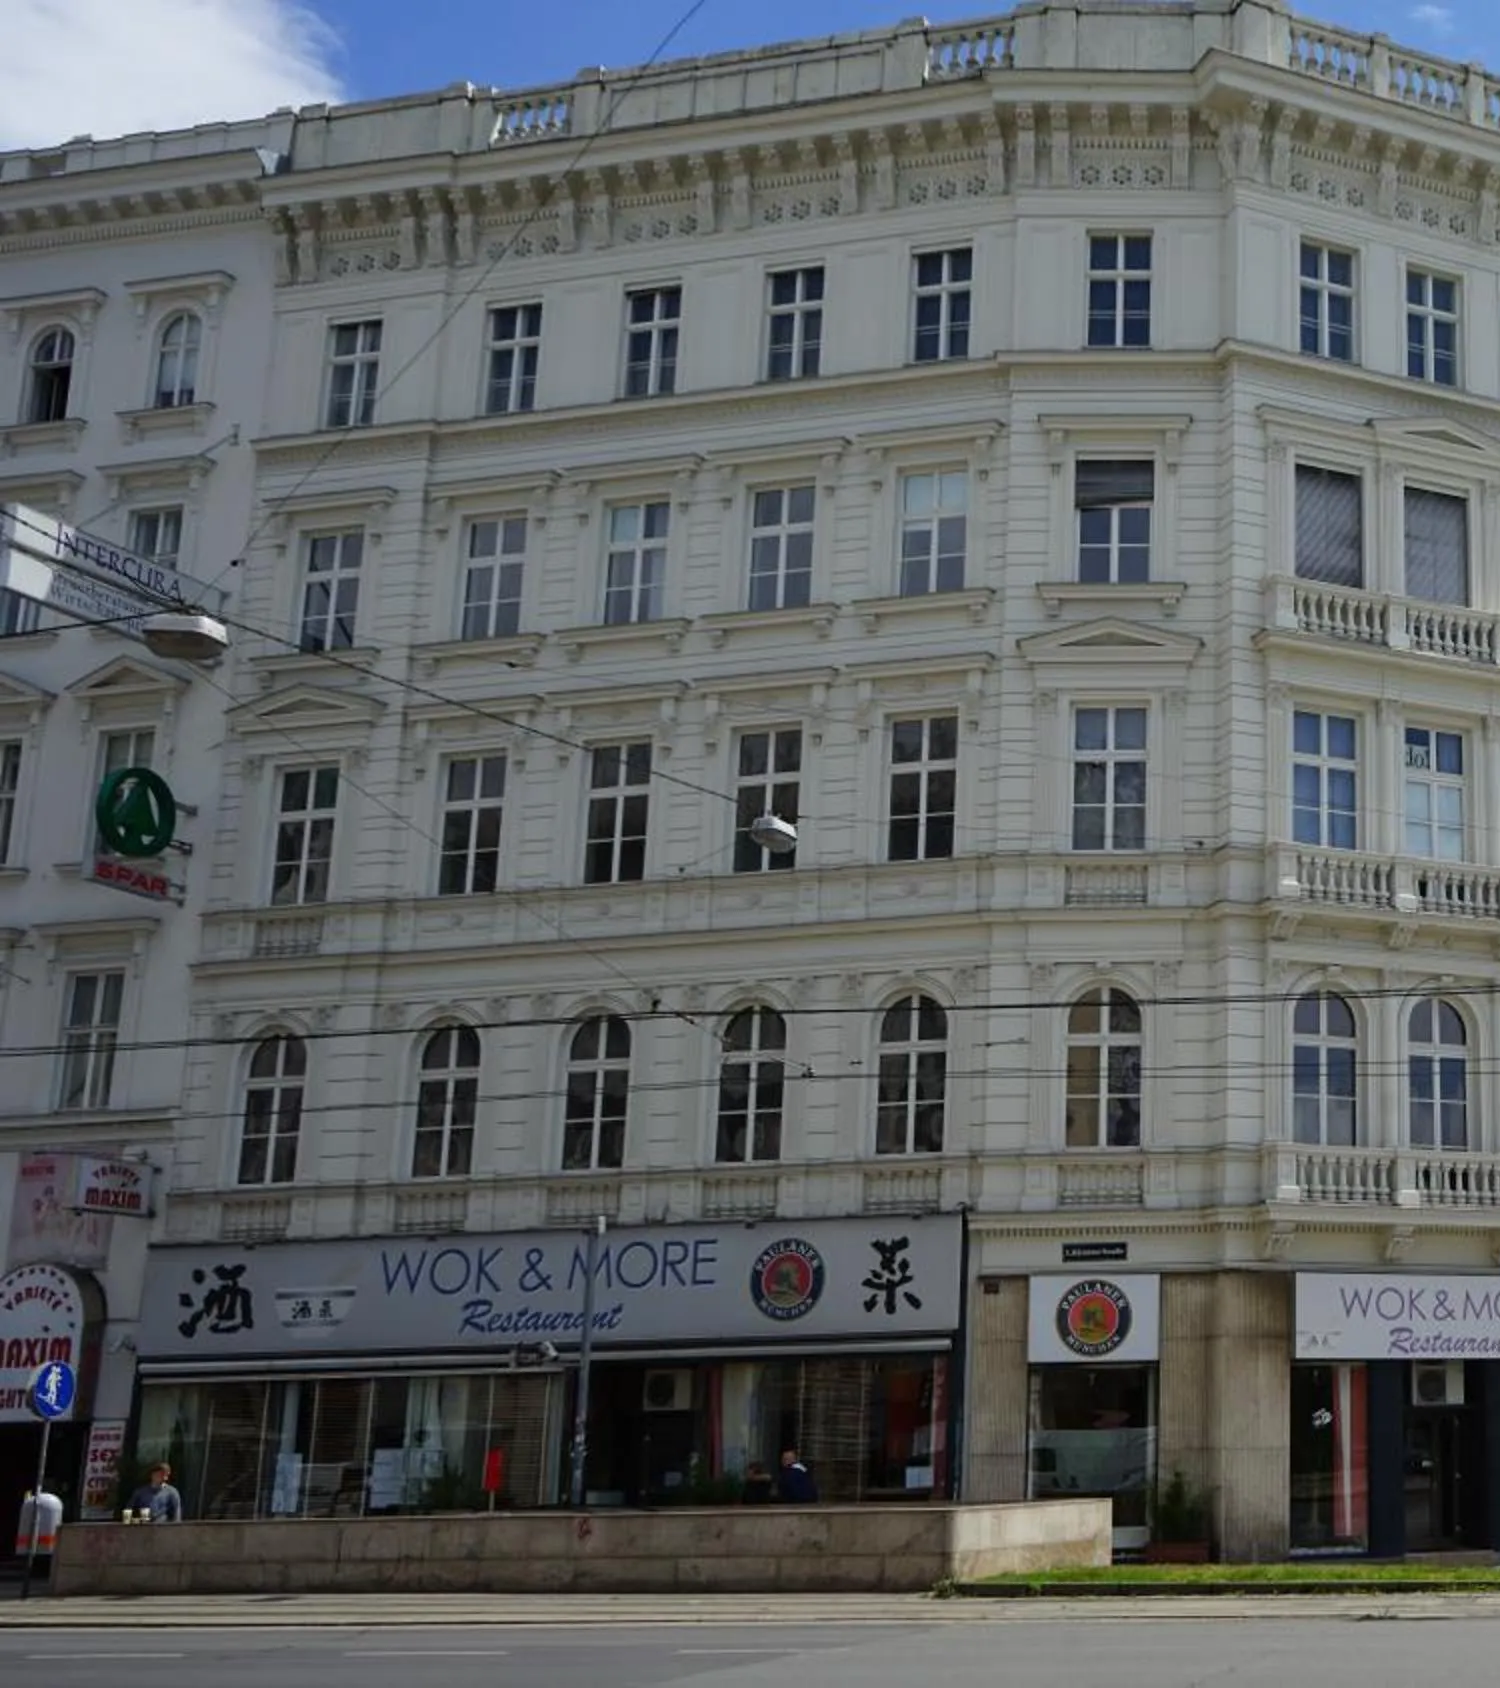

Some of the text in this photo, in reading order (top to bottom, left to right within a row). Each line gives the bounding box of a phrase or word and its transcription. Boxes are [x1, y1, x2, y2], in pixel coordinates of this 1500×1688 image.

[96, 861, 167, 896] SPAR
[85, 1187, 141, 1210] MAXIM
[382, 1238, 719, 1296] WOK & MORE
[1060, 1282, 1127, 1310] PAULANER
[1340, 1286, 1427, 1322] WOK
[1433, 1289, 1458, 1322] &
[458, 1299, 623, 1337] Restaurant
[0, 1337, 71, 1369] AXIM
